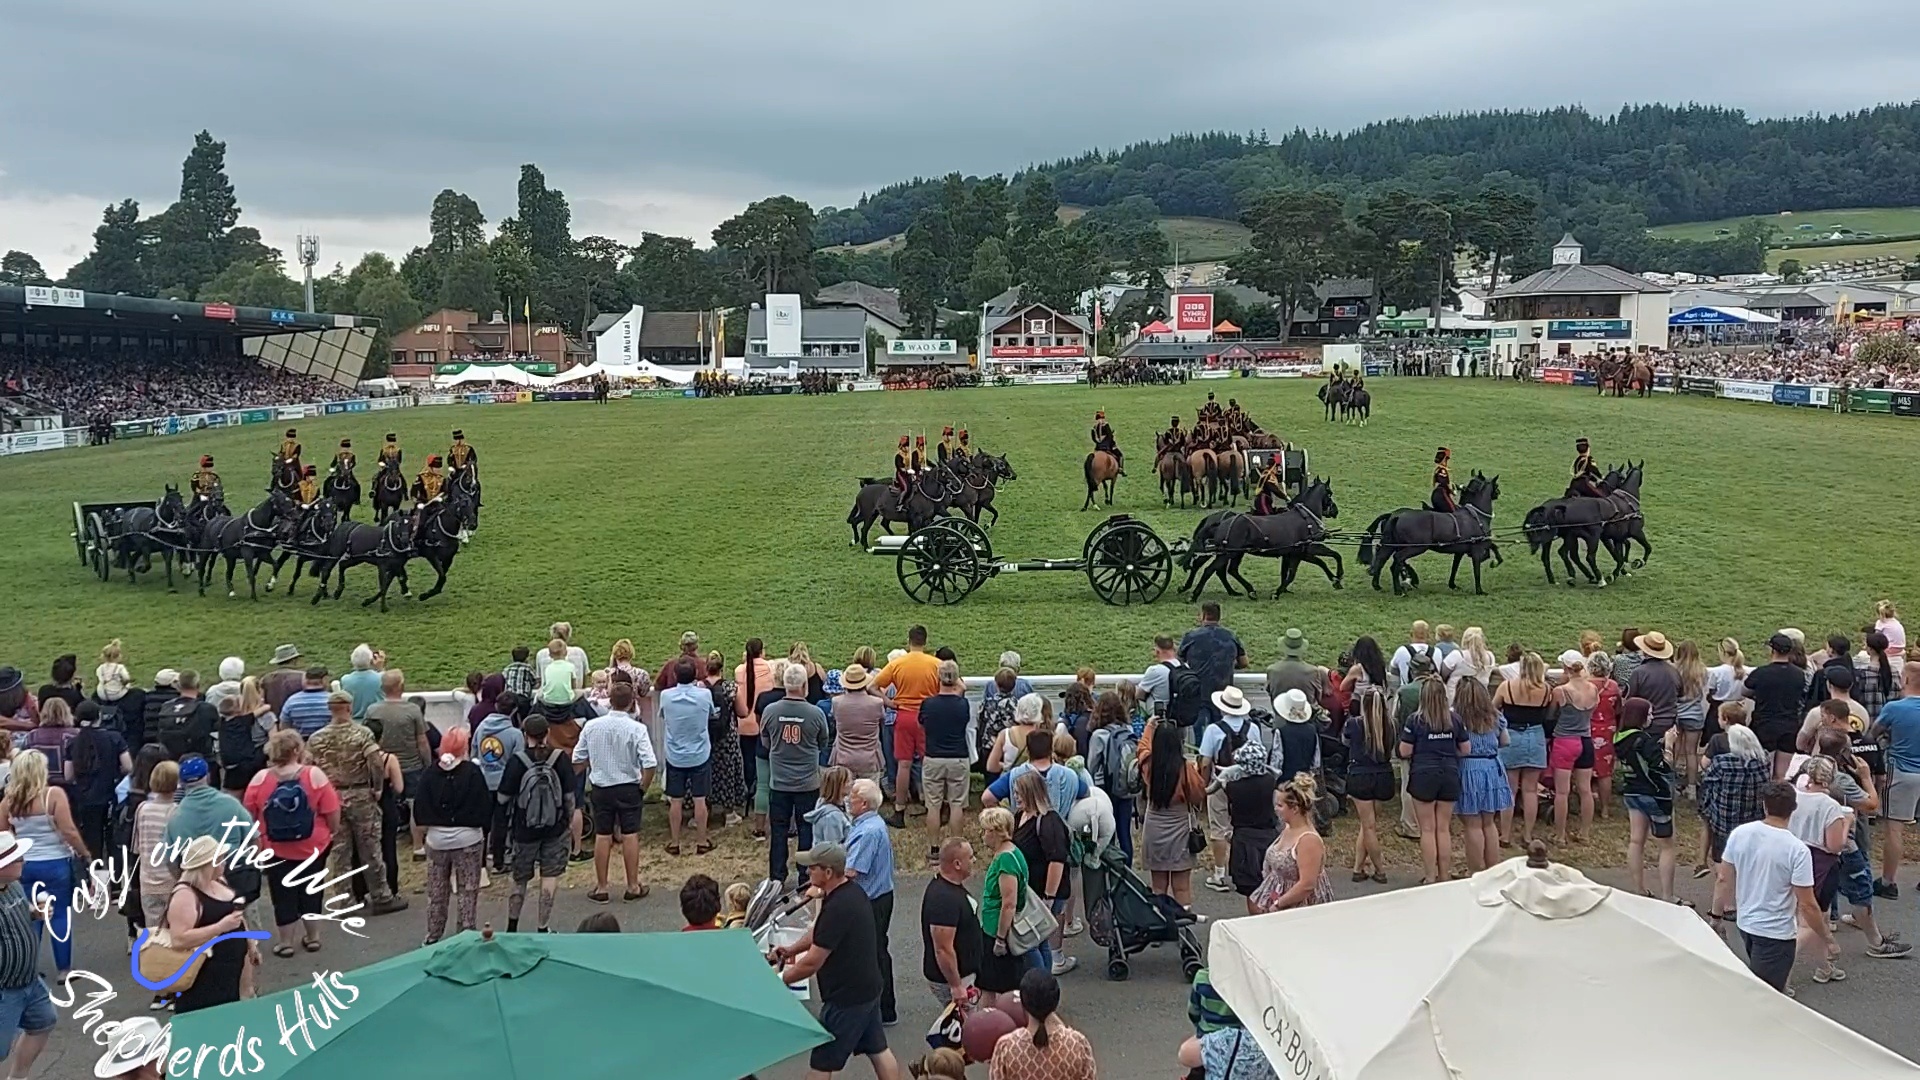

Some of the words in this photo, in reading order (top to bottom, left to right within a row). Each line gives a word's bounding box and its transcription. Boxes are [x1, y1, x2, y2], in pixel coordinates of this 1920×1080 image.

[775, 310, 790, 318] itv
[423, 324, 440, 332] NFU
[541, 326, 558, 334] NFU
[622, 320, 632, 353] Mutual
[623, 354, 632, 366] FU
[1897, 396, 1912, 405] M&S
[782, 724, 801, 744] 49
[1428, 731, 1453, 739] Rachel
[1851, 744, 1878, 754] TRONAS
